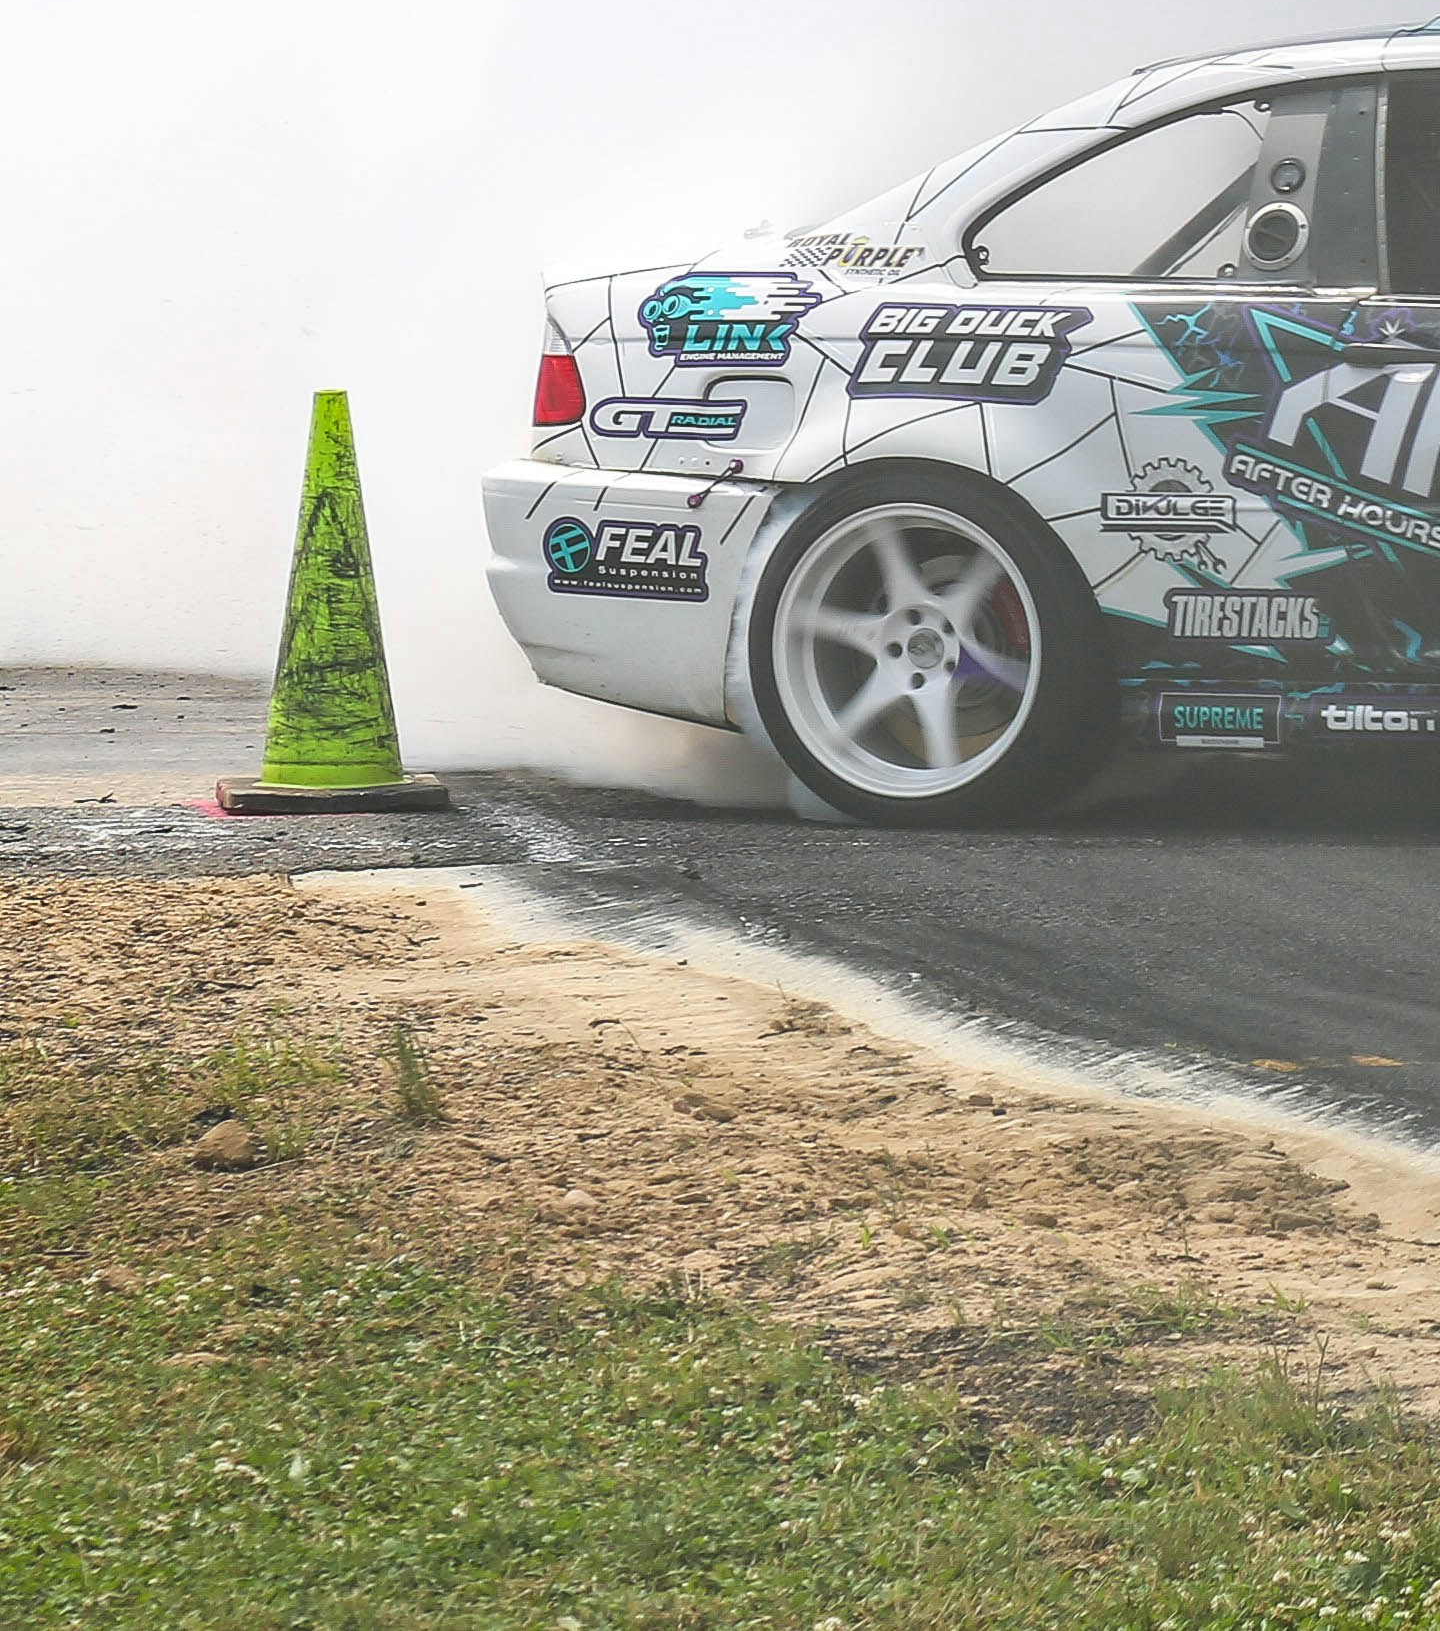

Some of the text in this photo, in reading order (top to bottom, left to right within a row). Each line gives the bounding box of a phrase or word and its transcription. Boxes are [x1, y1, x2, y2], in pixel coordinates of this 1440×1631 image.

[822, 245, 917, 269] PURPLE
[867, 308, 942, 335] BIG
[682, 322, 796, 352] LINK
[855, 338, 1053, 386] CLUB
[670, 414, 737, 427] RADIAL
[1230, 453, 1330, 512] AFTER
[595, 526, 703, 567] FEAL
[553, 578, 703, 594] www.fealsuspension.com
[597, 565, 699, 581] Suspension
[1171, 595, 1320, 639] TIRESTACKS
[1173, 705, 1264, 730] SUPREME
